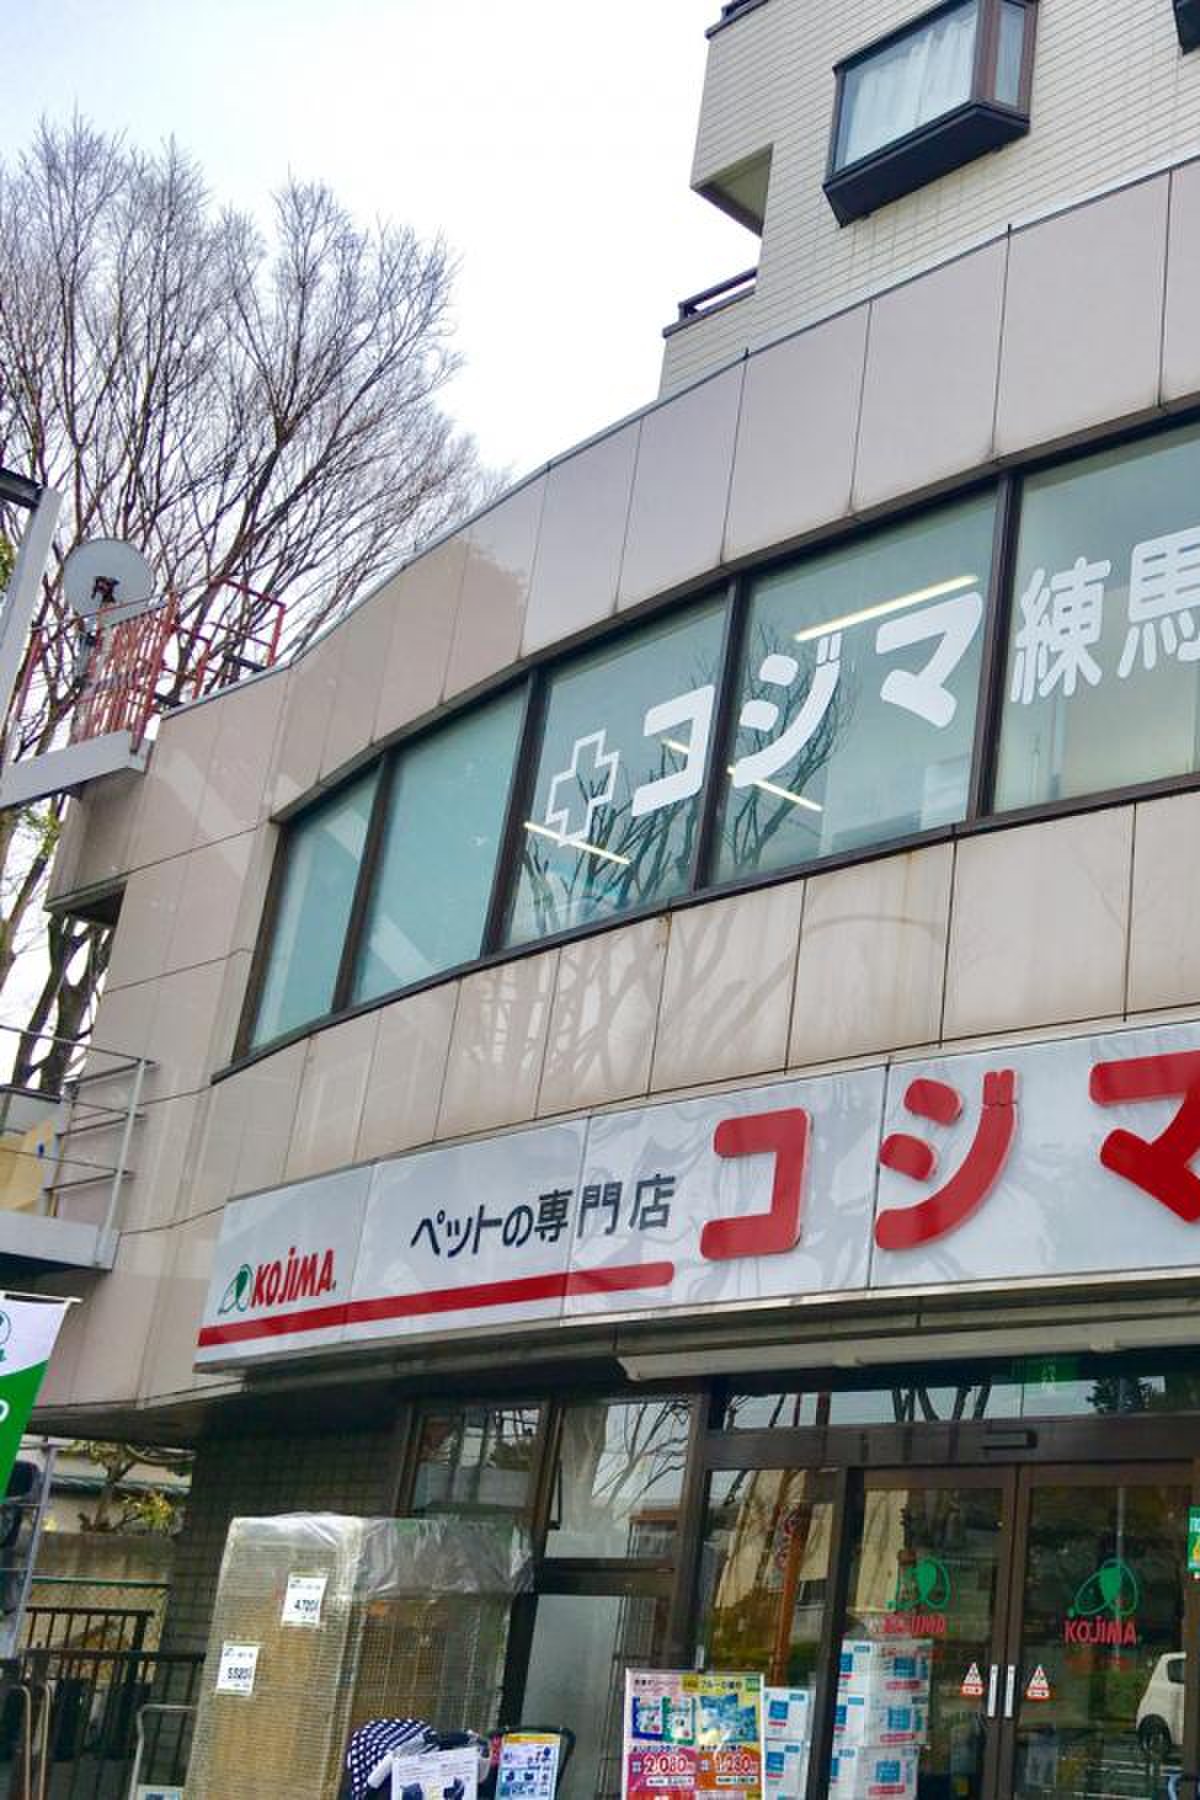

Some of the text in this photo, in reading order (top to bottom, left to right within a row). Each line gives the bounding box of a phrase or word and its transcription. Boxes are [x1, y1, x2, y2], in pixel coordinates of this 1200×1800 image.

[410, 1173, 676, 1259] ペットの専門店
[1064, 1616, 1137, 1646] KOJIMA
